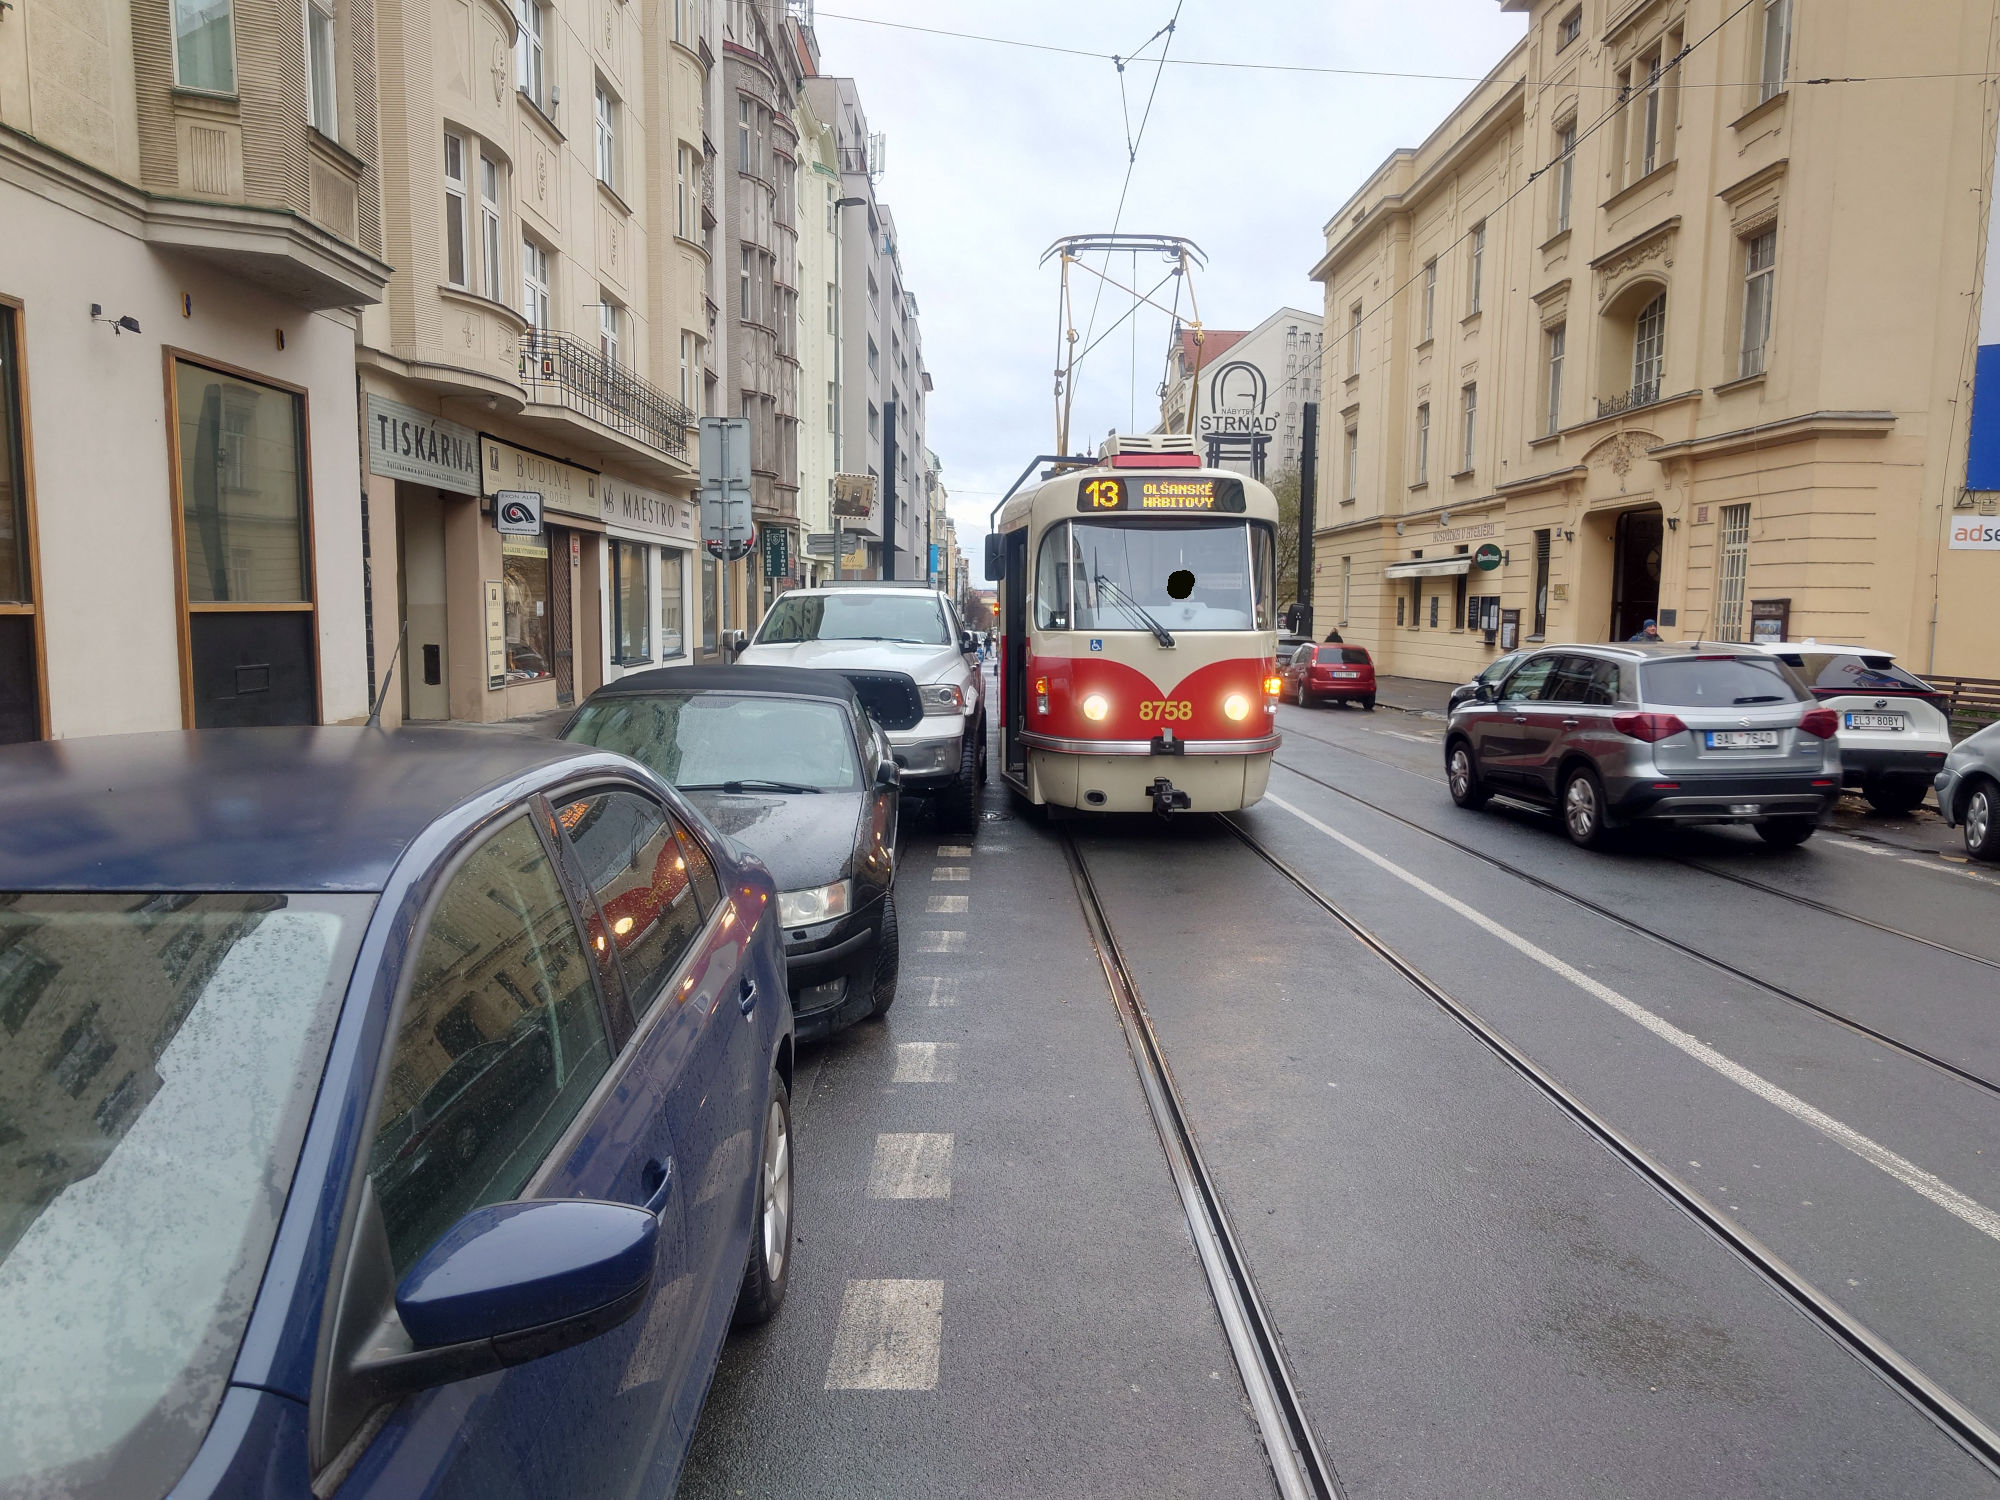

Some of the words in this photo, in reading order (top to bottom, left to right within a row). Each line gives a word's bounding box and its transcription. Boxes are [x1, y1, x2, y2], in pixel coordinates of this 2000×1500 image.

[1200, 416, 1277, 431] STRNAD
[377, 413, 474, 474] TISKÁRNA
[516, 454, 570, 490] BUDINA
[1085, 481, 1119, 507] 13
[1143, 482, 1213, 495] OLŠANSKÉ
[623, 491, 675, 527] MAESTRO
[1143, 495, 1215, 507] HŘBITOVY
[1139, 701, 1193, 721] 8758
